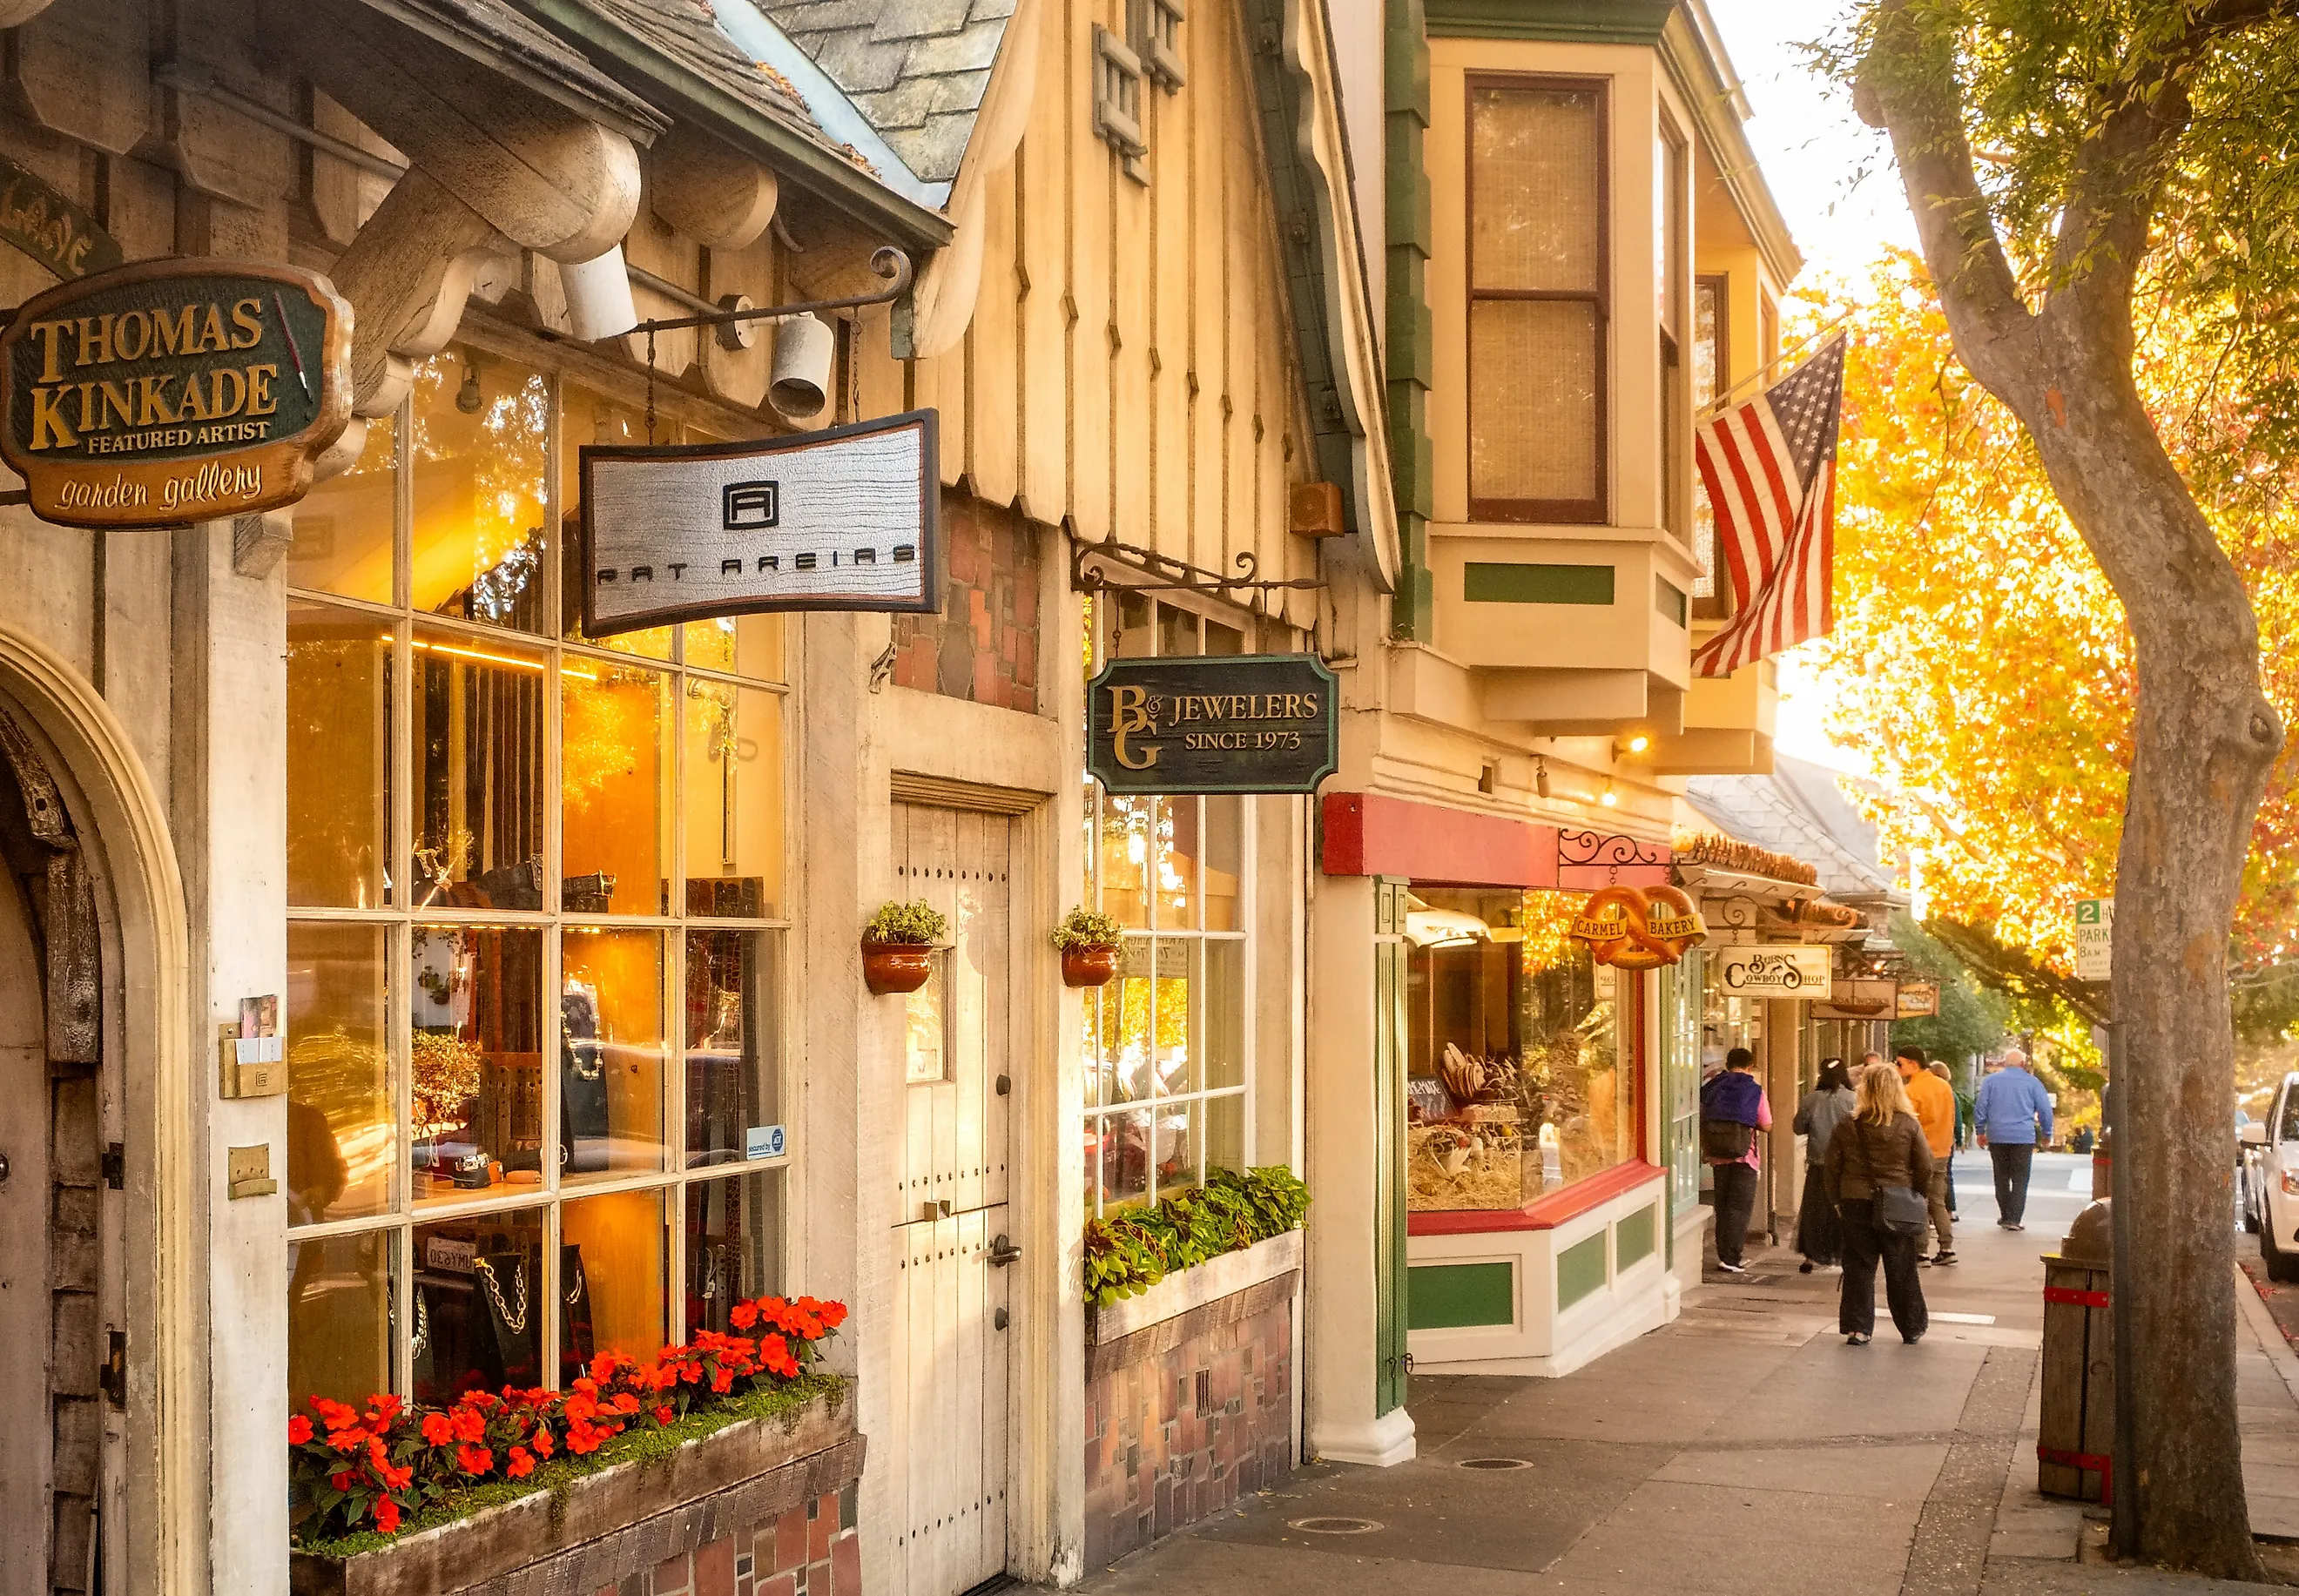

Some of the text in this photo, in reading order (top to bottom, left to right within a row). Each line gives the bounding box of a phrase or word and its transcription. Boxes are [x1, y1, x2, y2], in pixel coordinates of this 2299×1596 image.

[30, 298, 262, 383] THOMAS
[29, 364, 279, 450] KINKADE
[88, 421, 270, 454] FEATURED ARTIST
[54, 460, 261, 511] garden gallery
[597, 544, 915, 585] PAT AREIAS
[1169, 693, 1318, 726] JEWELERS
[1185, 731, 1301, 751] SINCE 1973
[1577, 917, 1696, 936] CARMEL BAKERY
[2081, 904, 2094, 921] 2
[2080, 928, 2109, 943] PARK
[1724, 954, 1825, 989] COWBOY SHOP
